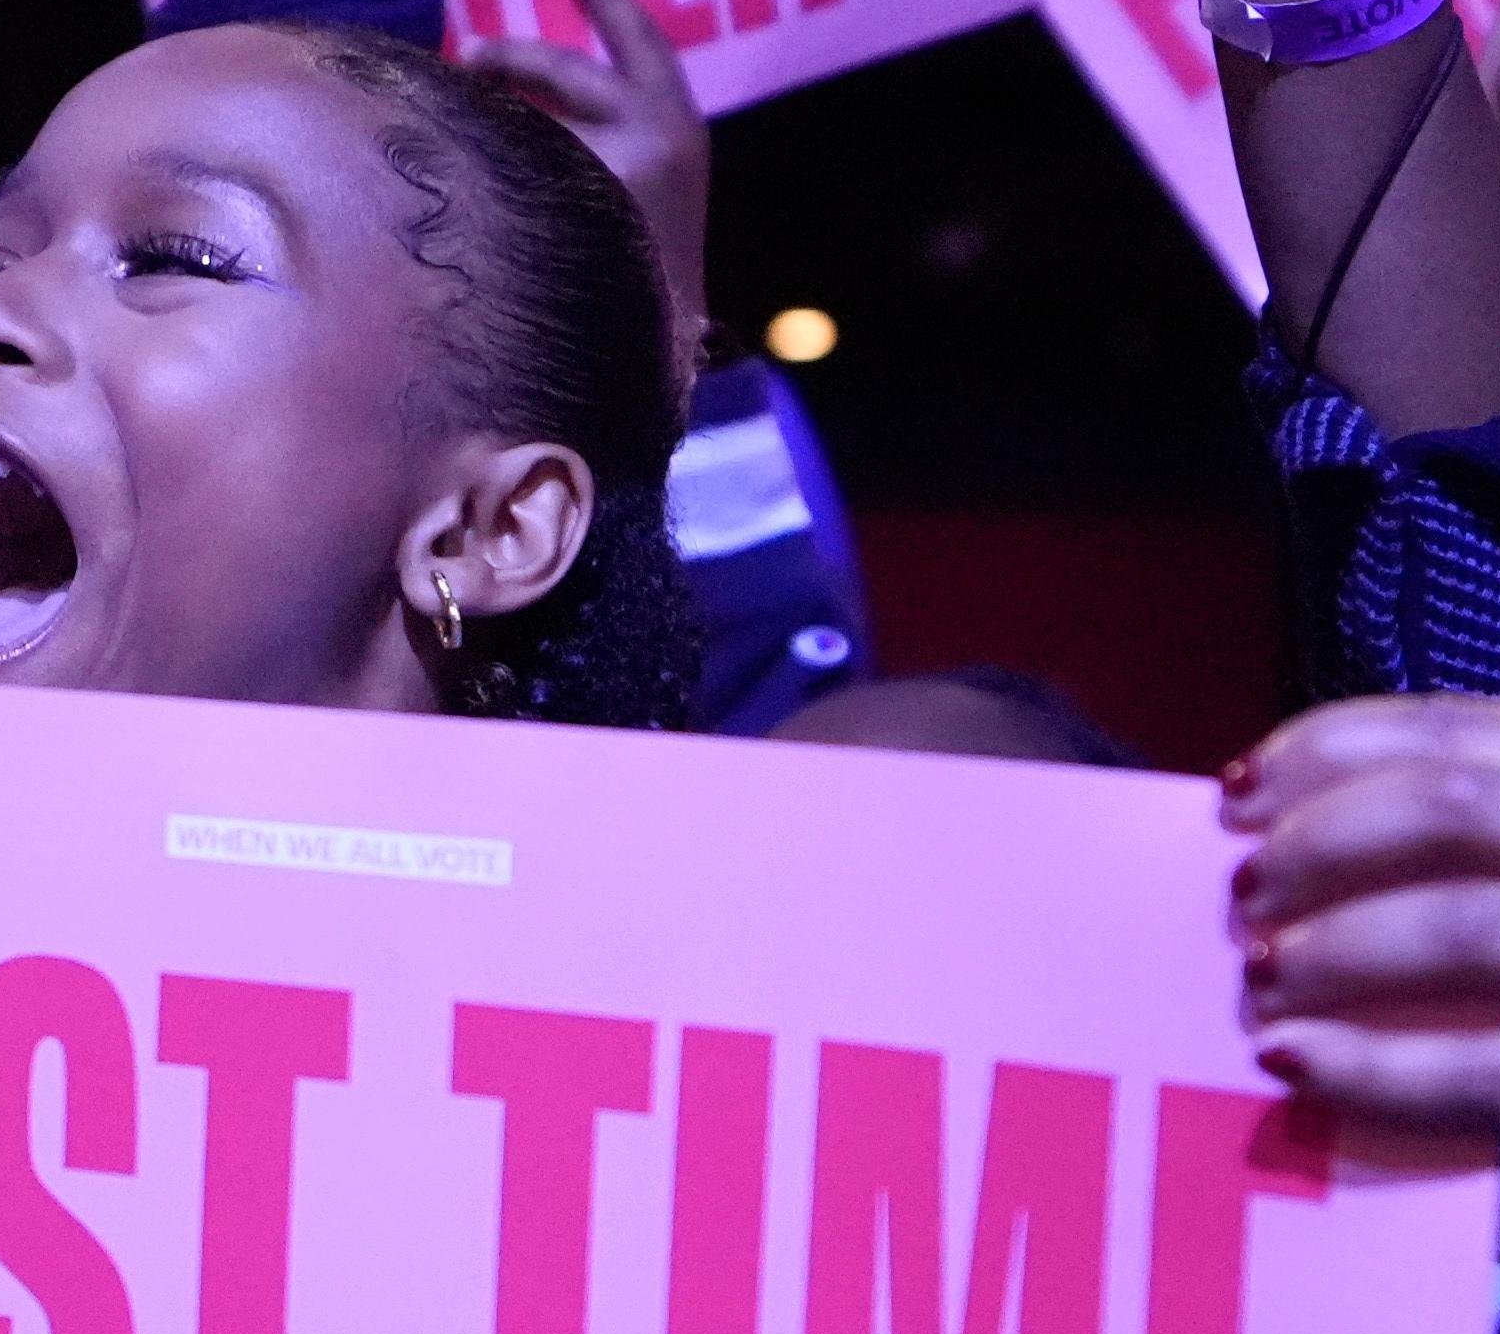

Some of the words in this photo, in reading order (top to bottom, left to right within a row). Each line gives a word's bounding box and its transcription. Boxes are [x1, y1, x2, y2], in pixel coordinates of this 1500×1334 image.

[174, 822, 278, 858] WHEN
[287, 832, 333, 863] WE
[349, 837, 407, 869] ALL
[415, 844, 498, 878] VOTE
